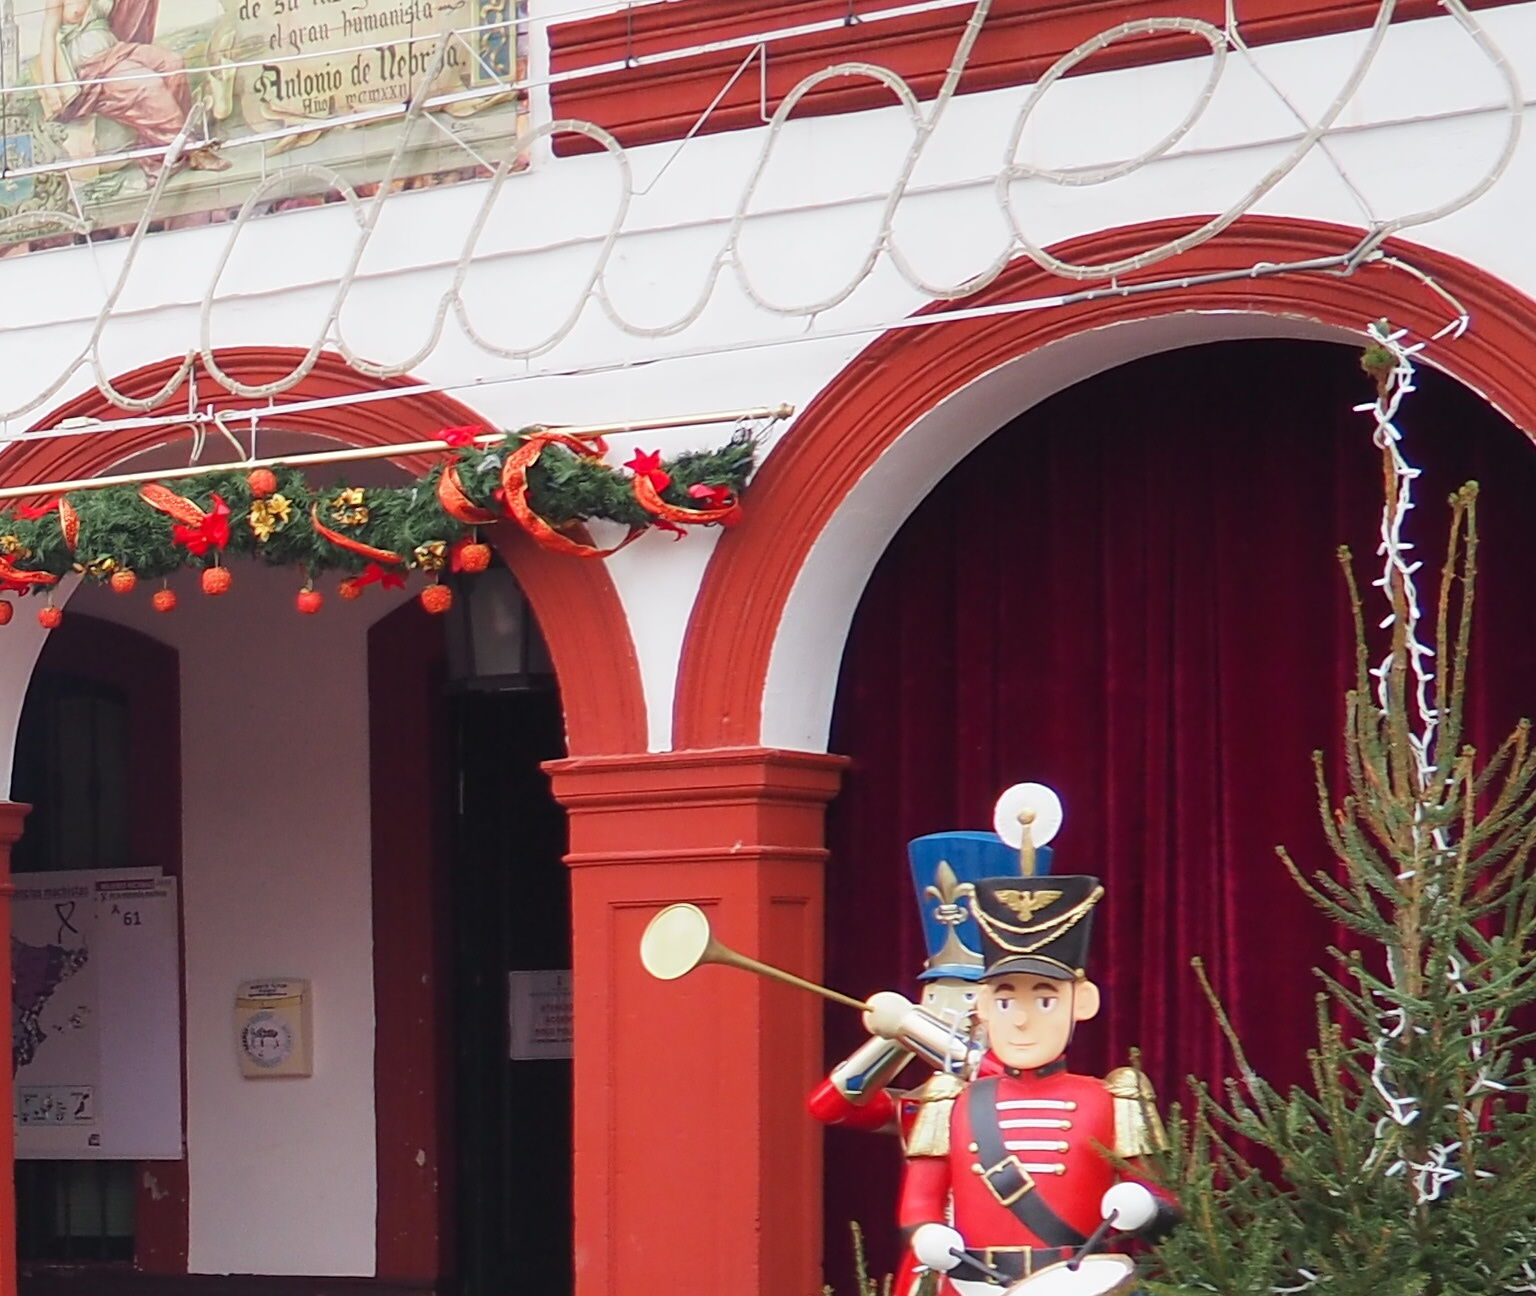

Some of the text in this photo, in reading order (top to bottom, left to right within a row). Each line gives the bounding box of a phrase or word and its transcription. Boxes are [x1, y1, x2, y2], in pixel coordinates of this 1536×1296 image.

[239, 2, 261, 21] de
[269, 2, 434, 54] el gran humanista
[253, 61, 343, 102] Antonio
[350, 54, 371, 85] de
[123, 911, 142, 926] 61
